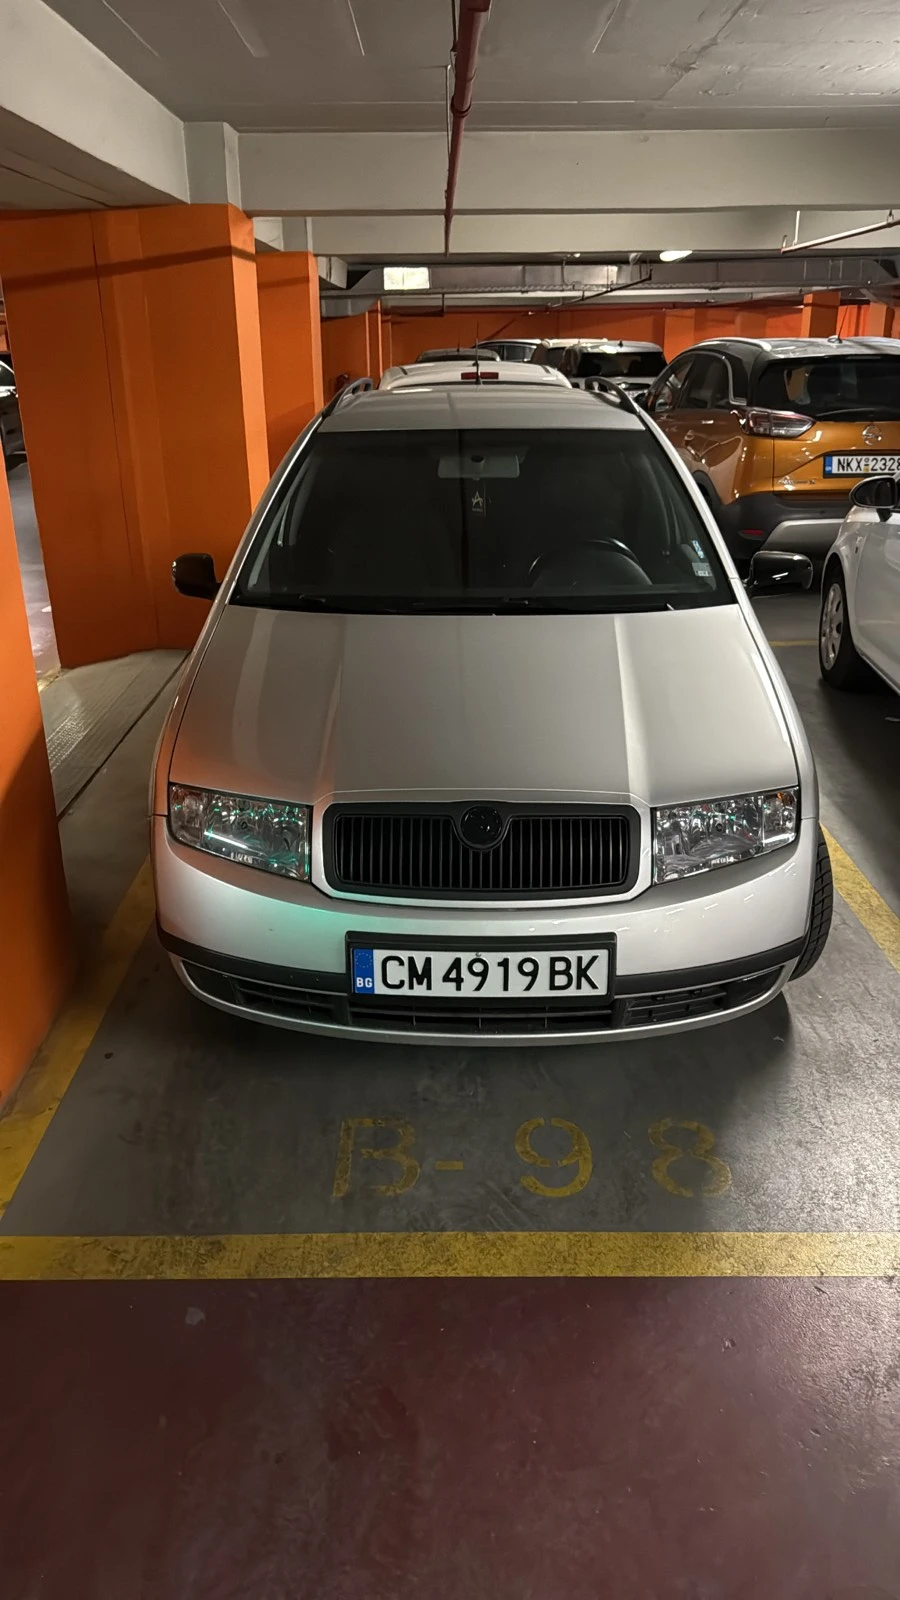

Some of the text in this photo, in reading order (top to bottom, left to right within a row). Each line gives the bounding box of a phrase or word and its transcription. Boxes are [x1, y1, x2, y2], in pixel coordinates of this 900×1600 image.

[356, 977, 373, 988] BG
[381, 955, 600, 992] CM 4919 BK
